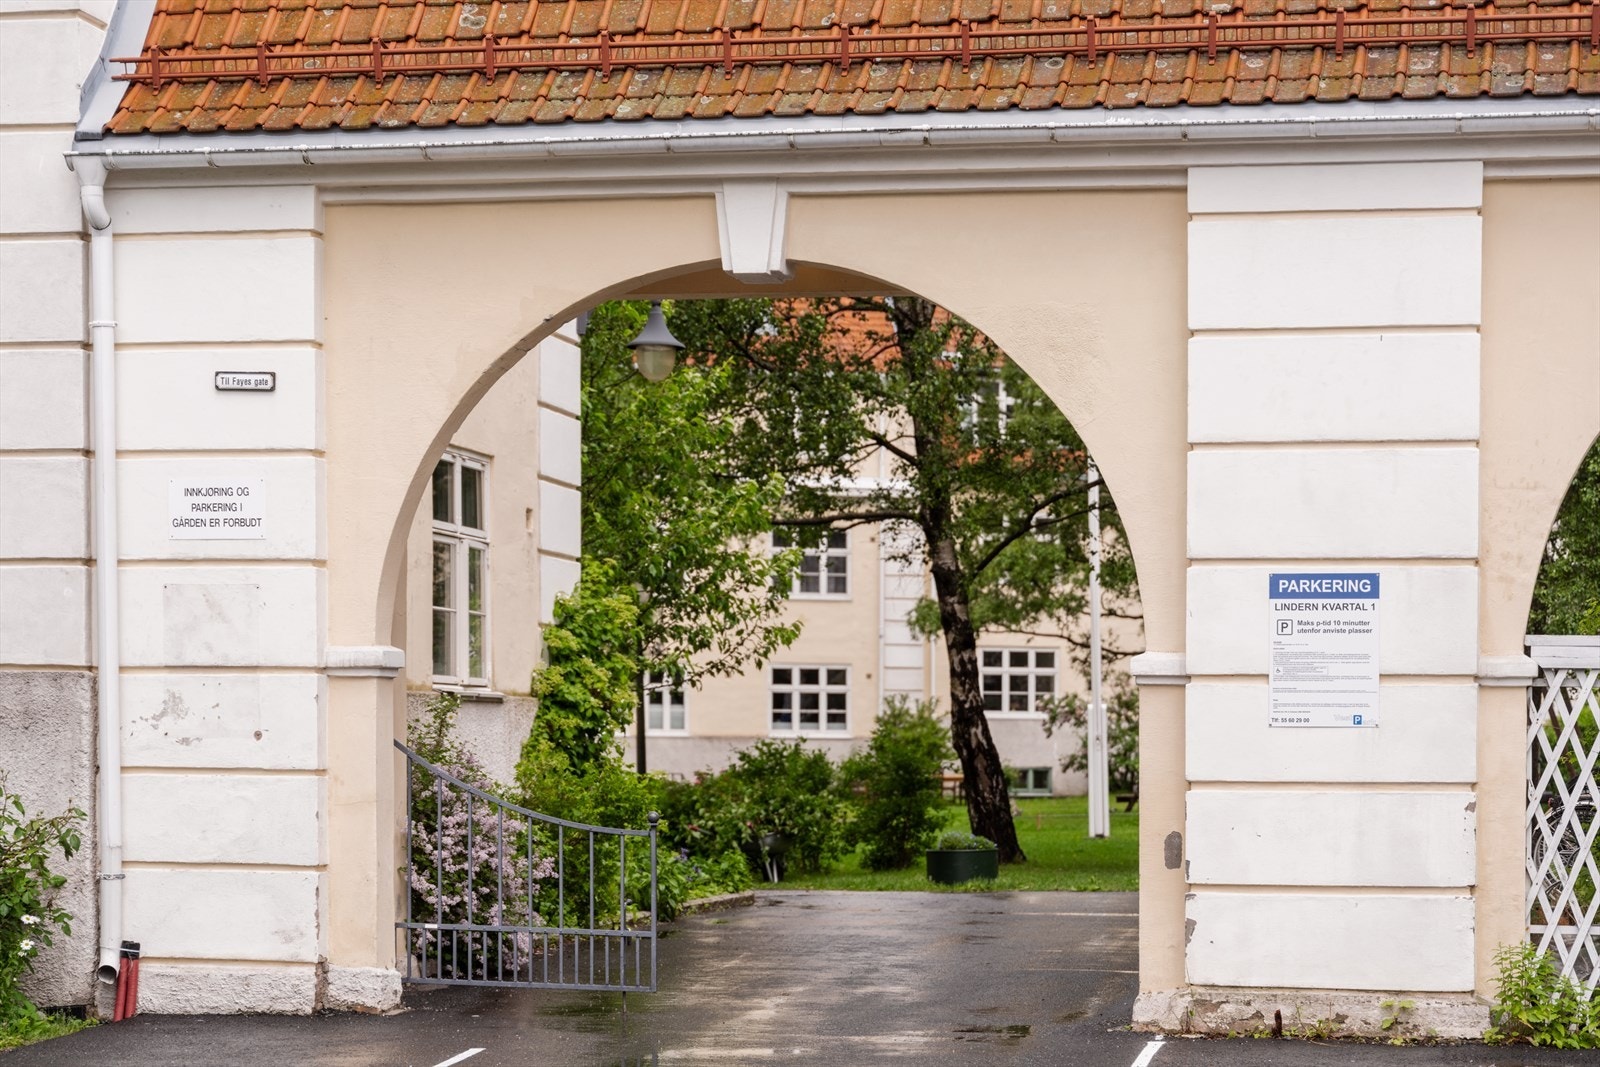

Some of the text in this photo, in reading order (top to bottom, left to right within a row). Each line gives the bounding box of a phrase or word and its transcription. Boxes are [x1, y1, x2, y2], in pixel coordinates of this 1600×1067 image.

[220, 376, 268, 387] Til Fayes gate
[236, 486, 250, 496] OG
[191, 502, 238, 512] PARKERING
[172, 516, 262, 528] GÅRDEN ER FORBUDT
[1278, 579, 1372, 593] PARKERING
[1274, 602, 1376, 611] LINDERN KVARTAL 1
[1281, 622, 1288, 632] P
[1316, 620, 1331, 628] p-tid
[1348, 628, 1372, 636] plasser
